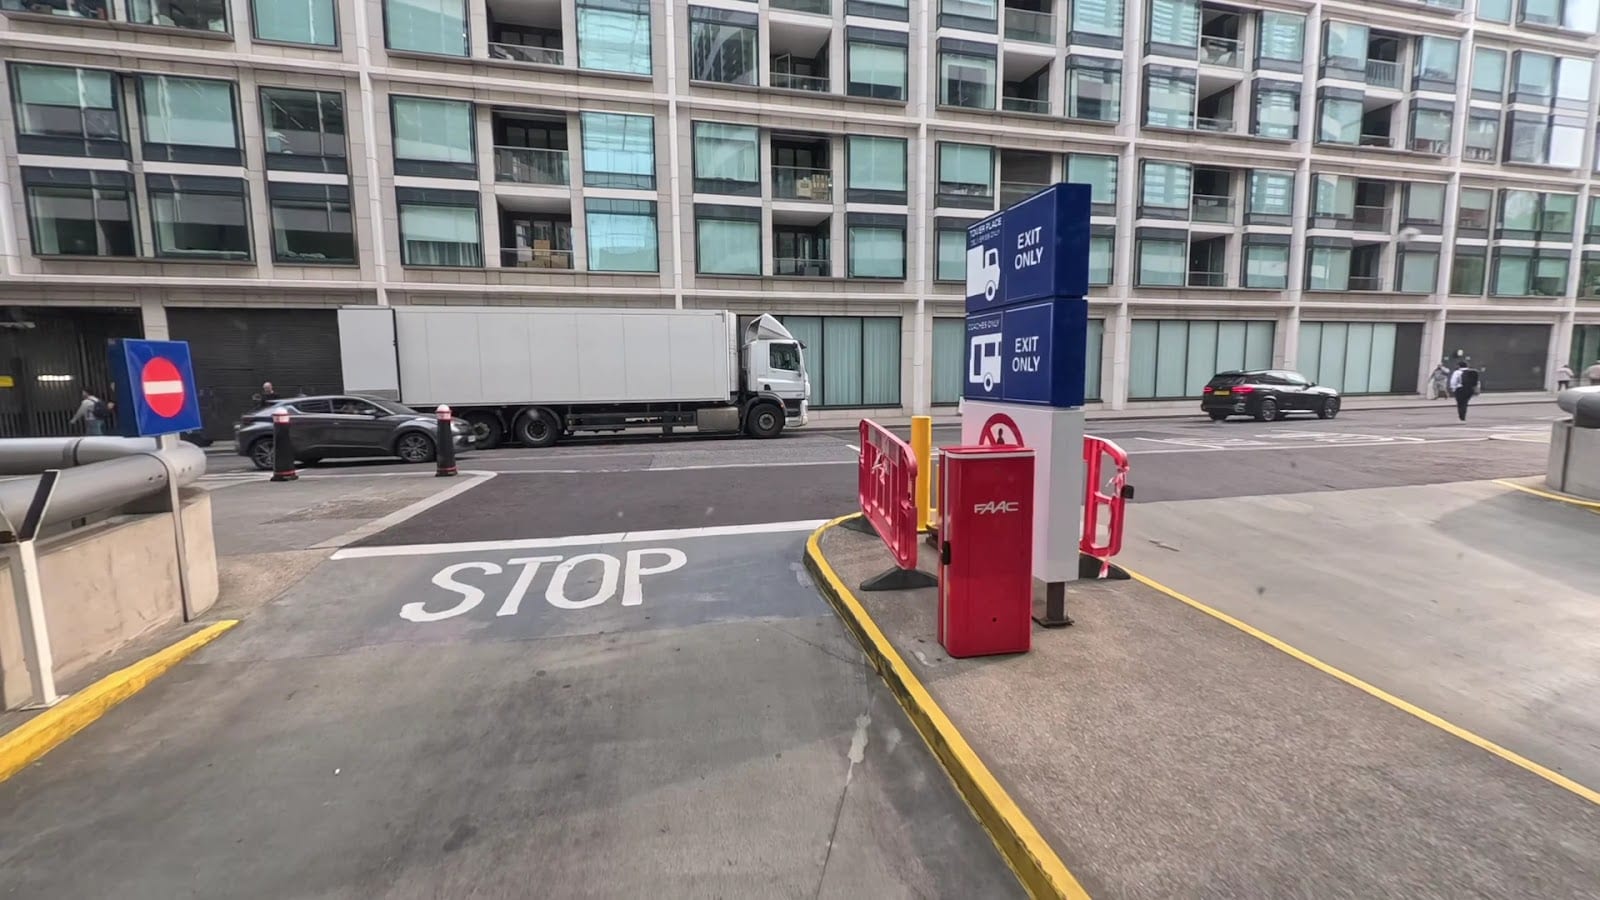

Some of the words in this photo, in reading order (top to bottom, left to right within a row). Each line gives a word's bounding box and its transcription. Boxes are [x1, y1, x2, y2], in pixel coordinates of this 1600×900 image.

[985, 216, 1002, 231] PLACE
[1017, 226, 1042, 249] EXIT
[1014, 247, 1044, 270] ONLY
[1015, 336, 1039, 353] EXIT
[1012, 356, 1041, 373] ONLY
[974, 501, 1019, 514] FAAC
[399, 548, 687, 622] STOP
